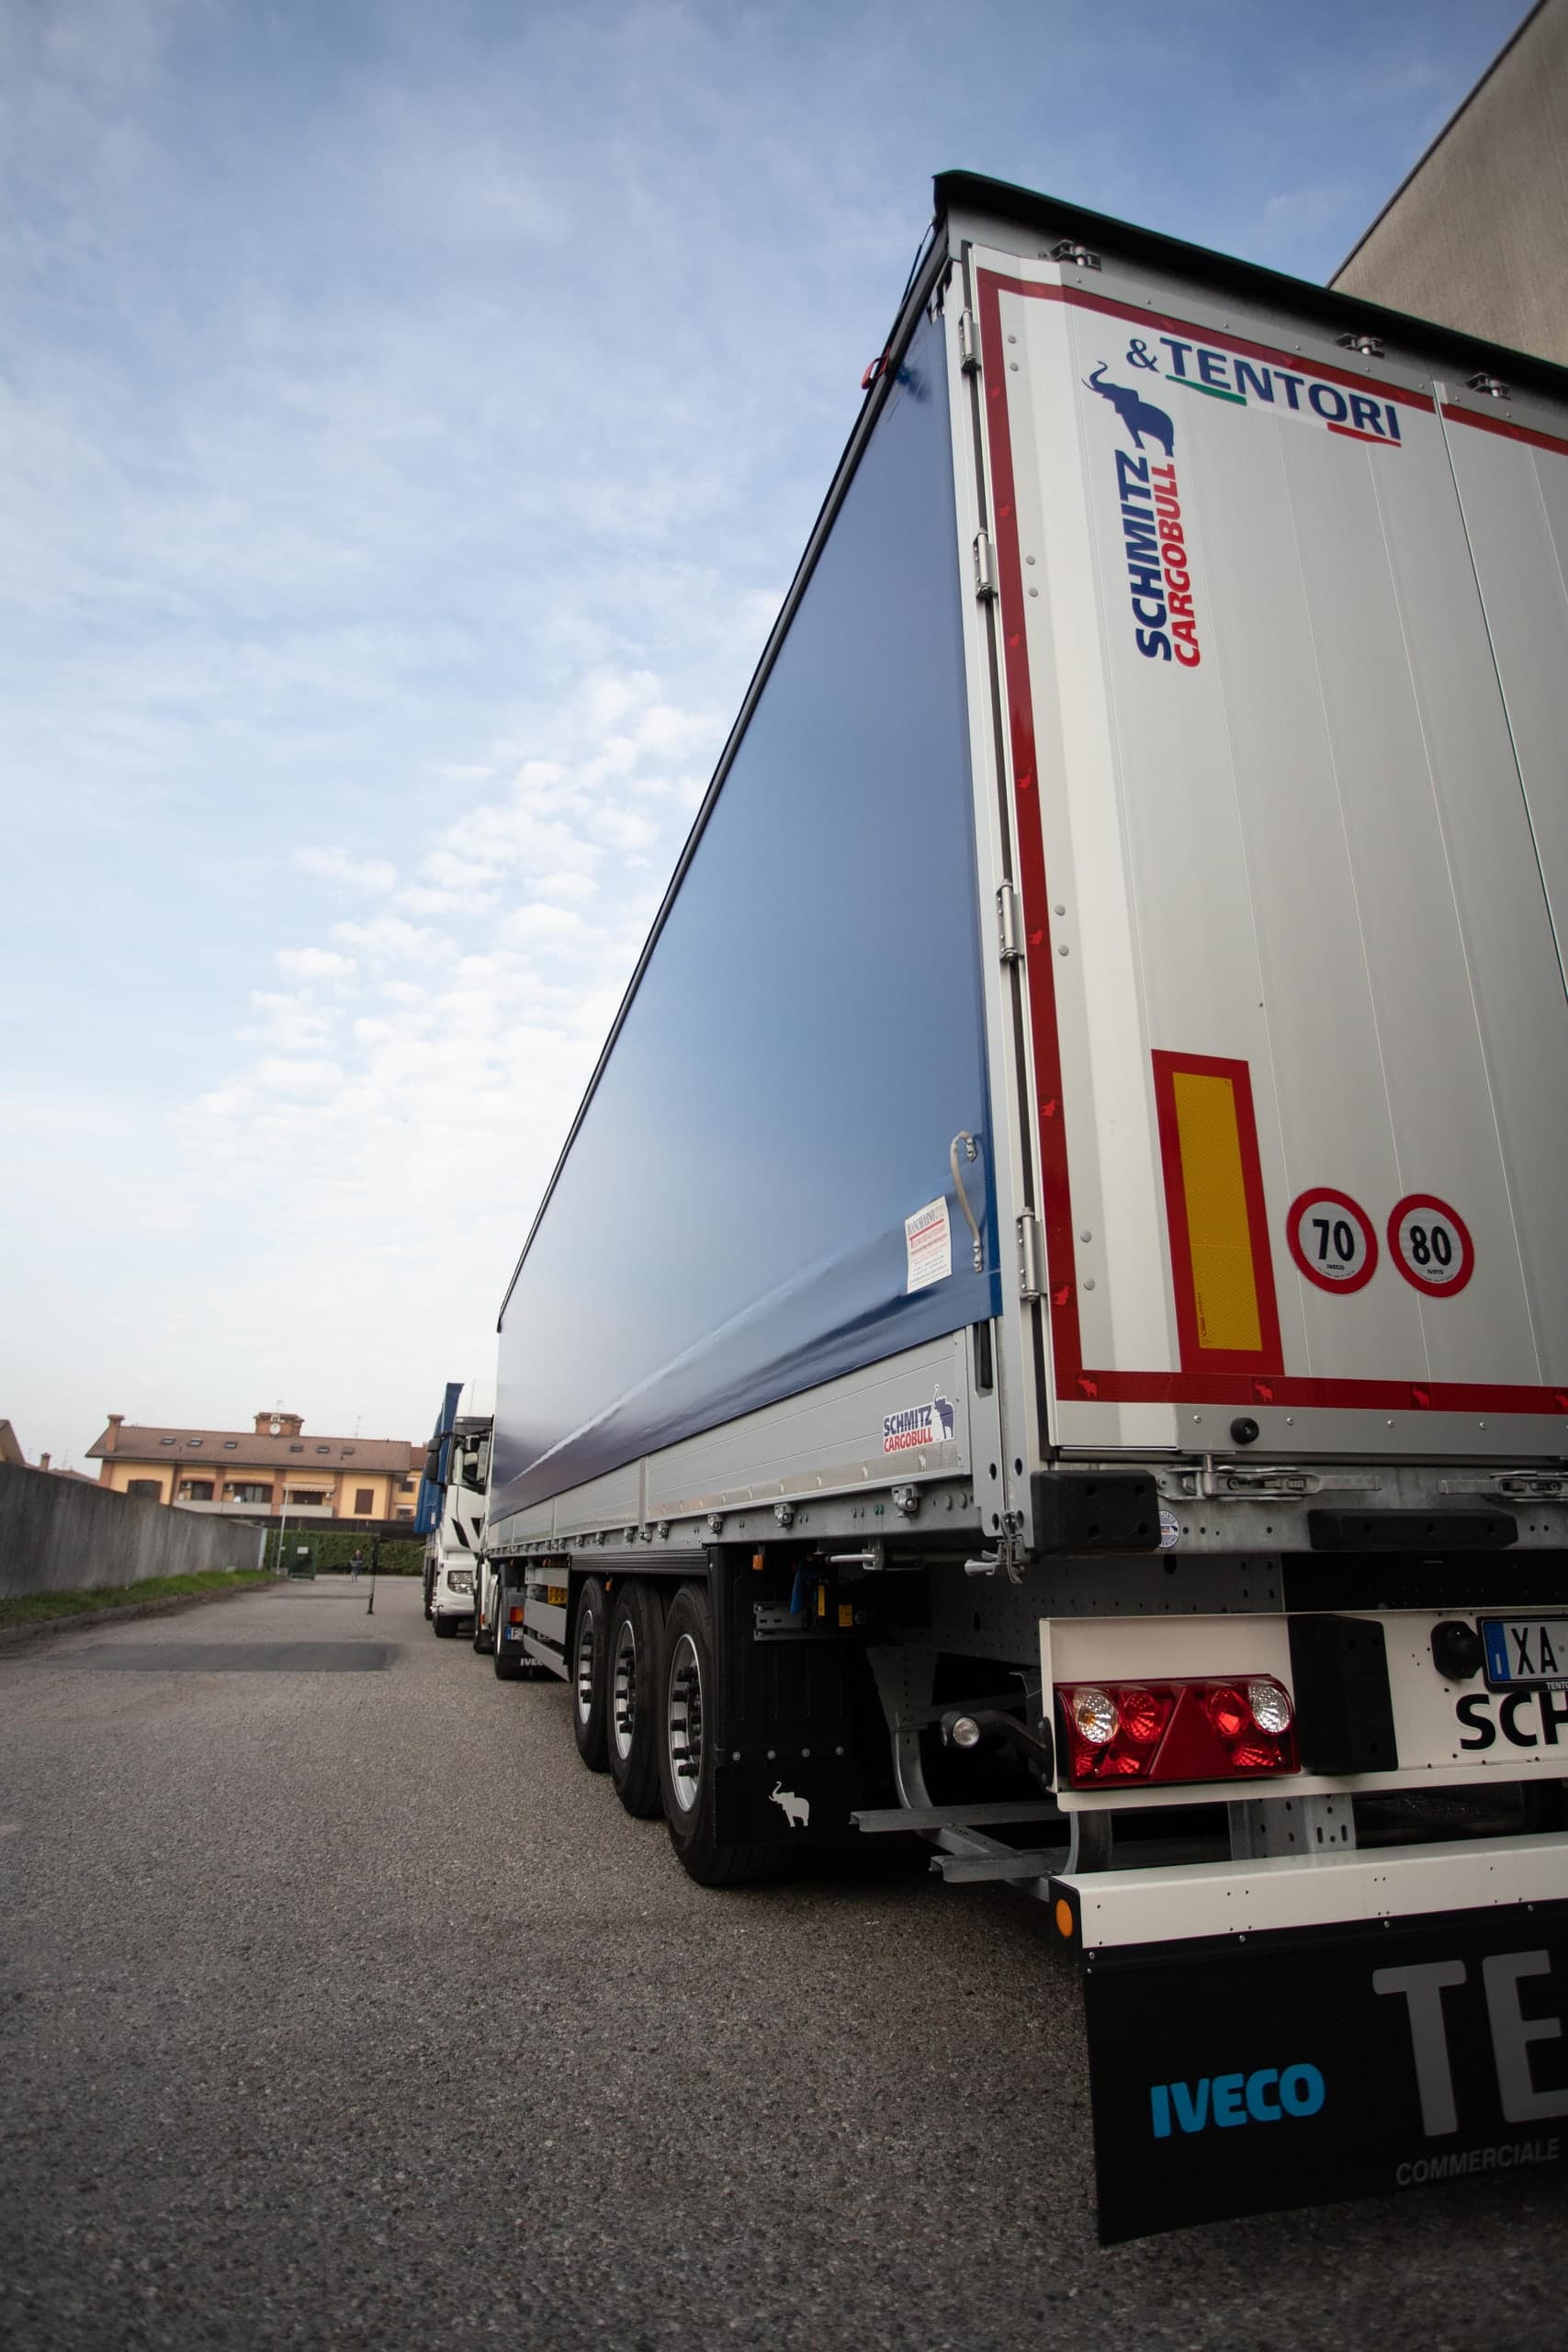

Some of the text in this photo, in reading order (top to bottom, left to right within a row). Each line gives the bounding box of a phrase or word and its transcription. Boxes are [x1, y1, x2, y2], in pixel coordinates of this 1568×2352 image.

[1125, 336, 1402, 441] & TENTORI
[1114, 448, 1172, 662] SCHMITZ
[1151, 462, 1201, 668] CARGOBULL
[1312, 1218, 1355, 1261] 70
[1409, 1225, 1451, 1266] 80
[884, 1404, 932, 1437] SCHMITZ
[884, 1427, 933, 1453] CARGOBULL
[1510, 1626, 1559, 1675] XA
[1455, 1690, 1568, 1750] SCH
[1371, 1949, 1568, 2137] TE
[1150, 2063, 1325, 2139] IVECO
[1395, 2138, 1561, 2186] COMMERCIALE
